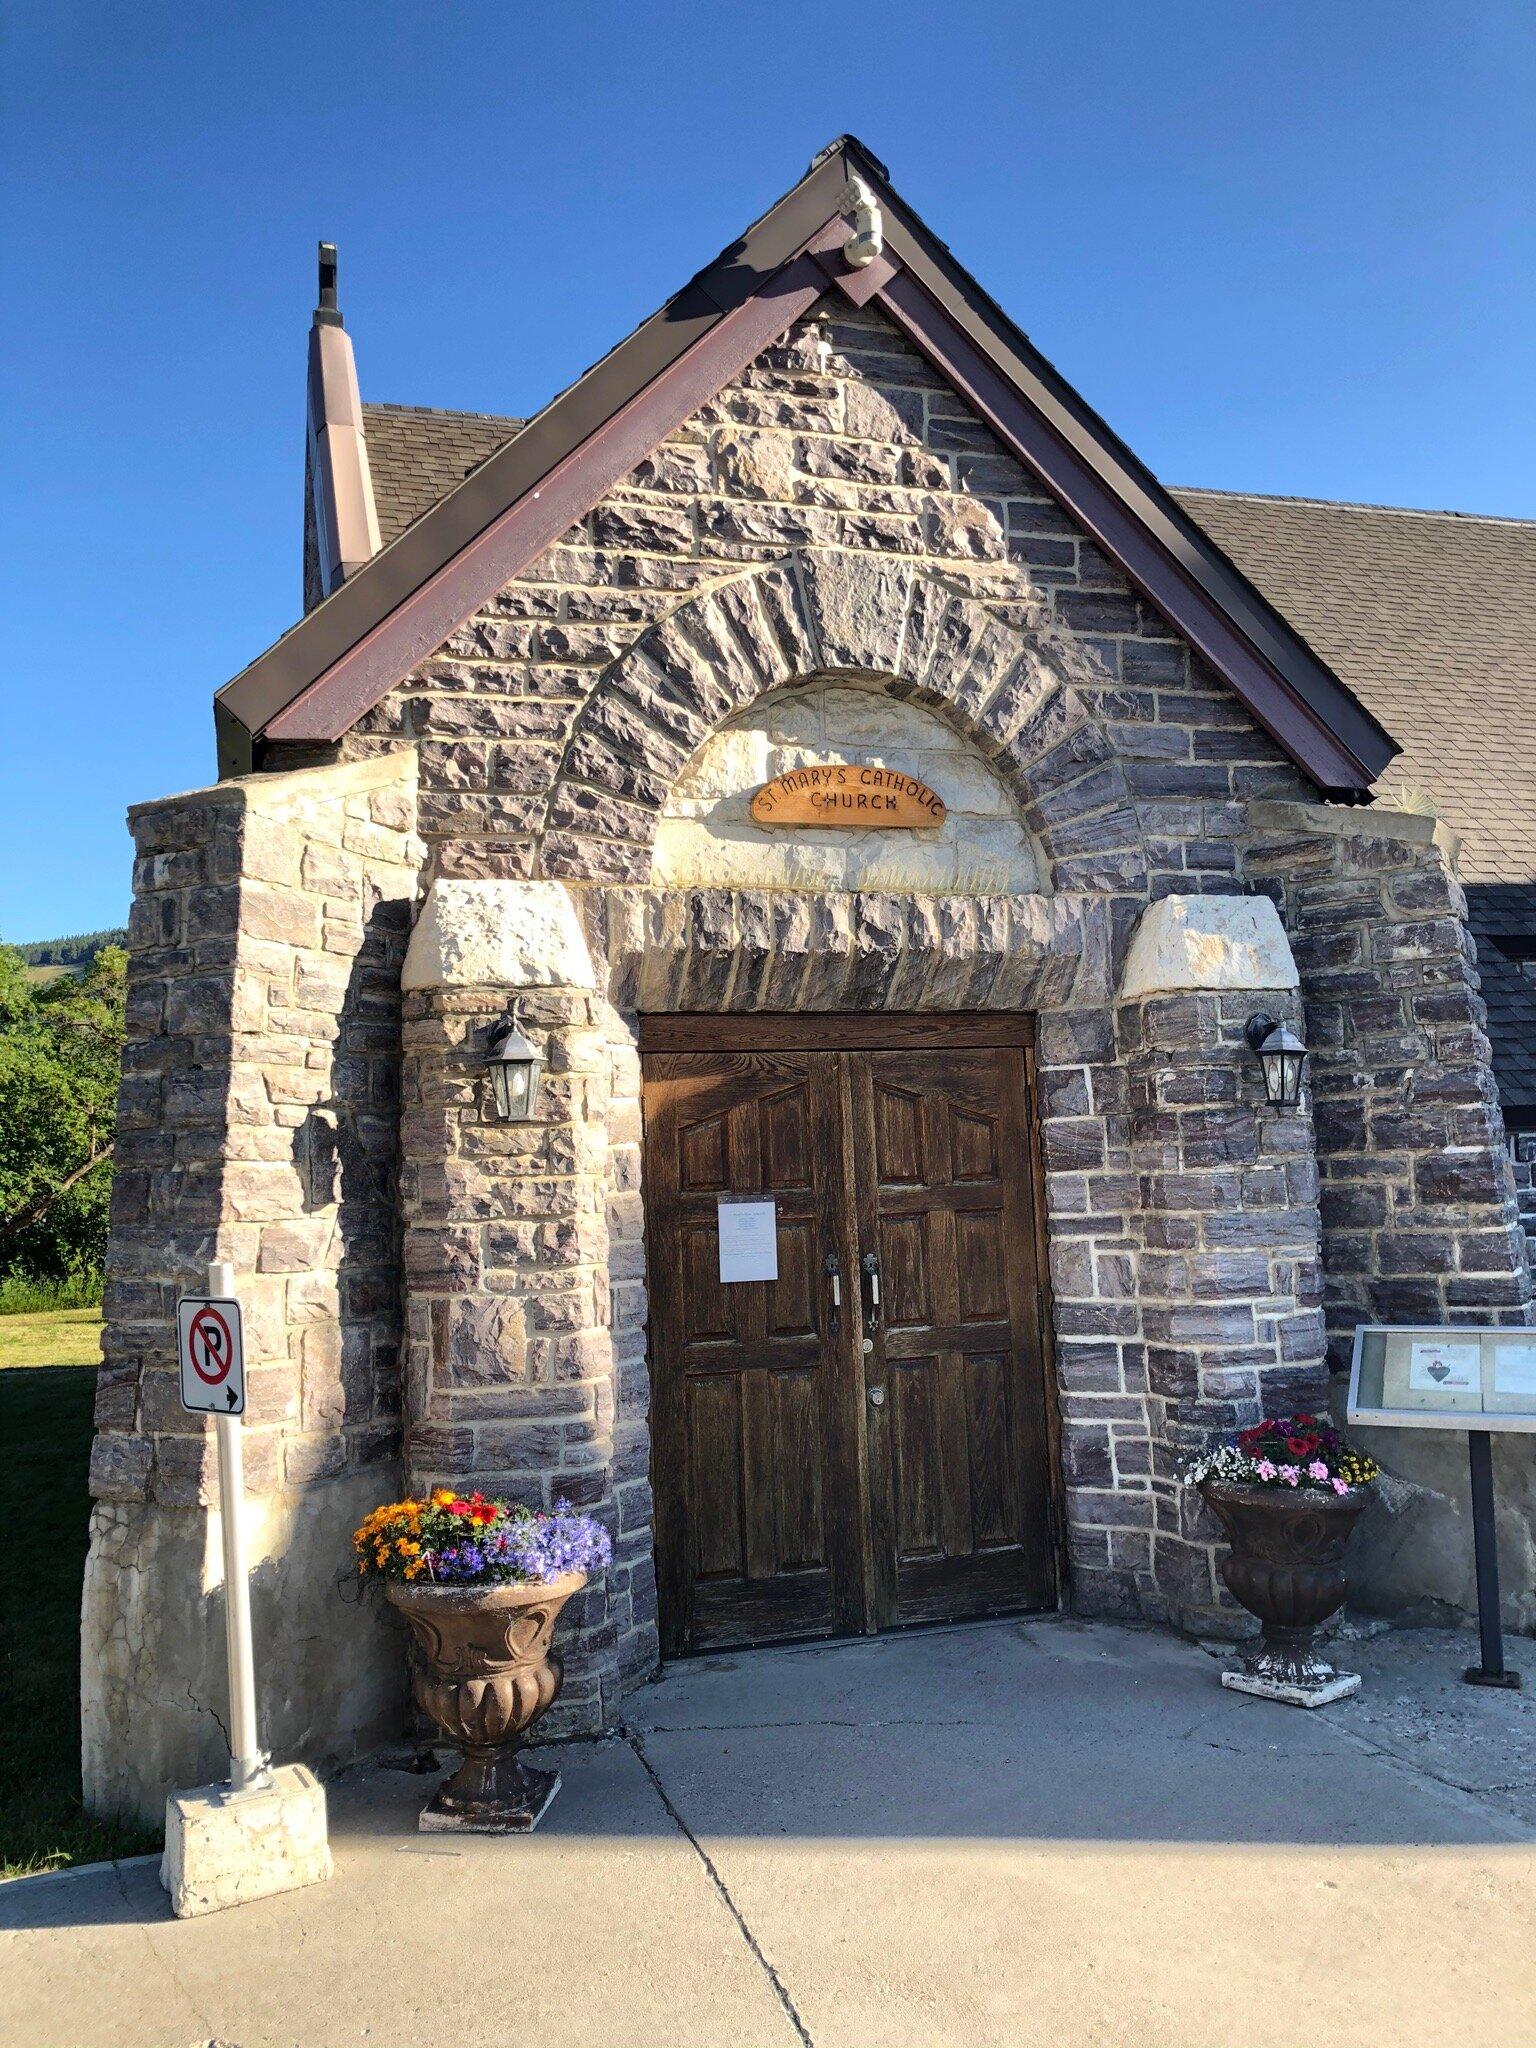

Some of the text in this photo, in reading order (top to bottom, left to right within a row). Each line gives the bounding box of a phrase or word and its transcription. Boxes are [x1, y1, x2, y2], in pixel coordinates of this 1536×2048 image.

[758, 788, 781, 812] ST.
[860, 769, 944, 816] CATHOLIC
[811, 792, 897, 810] CHURCH
[204, 1326, 222, 1366] P
